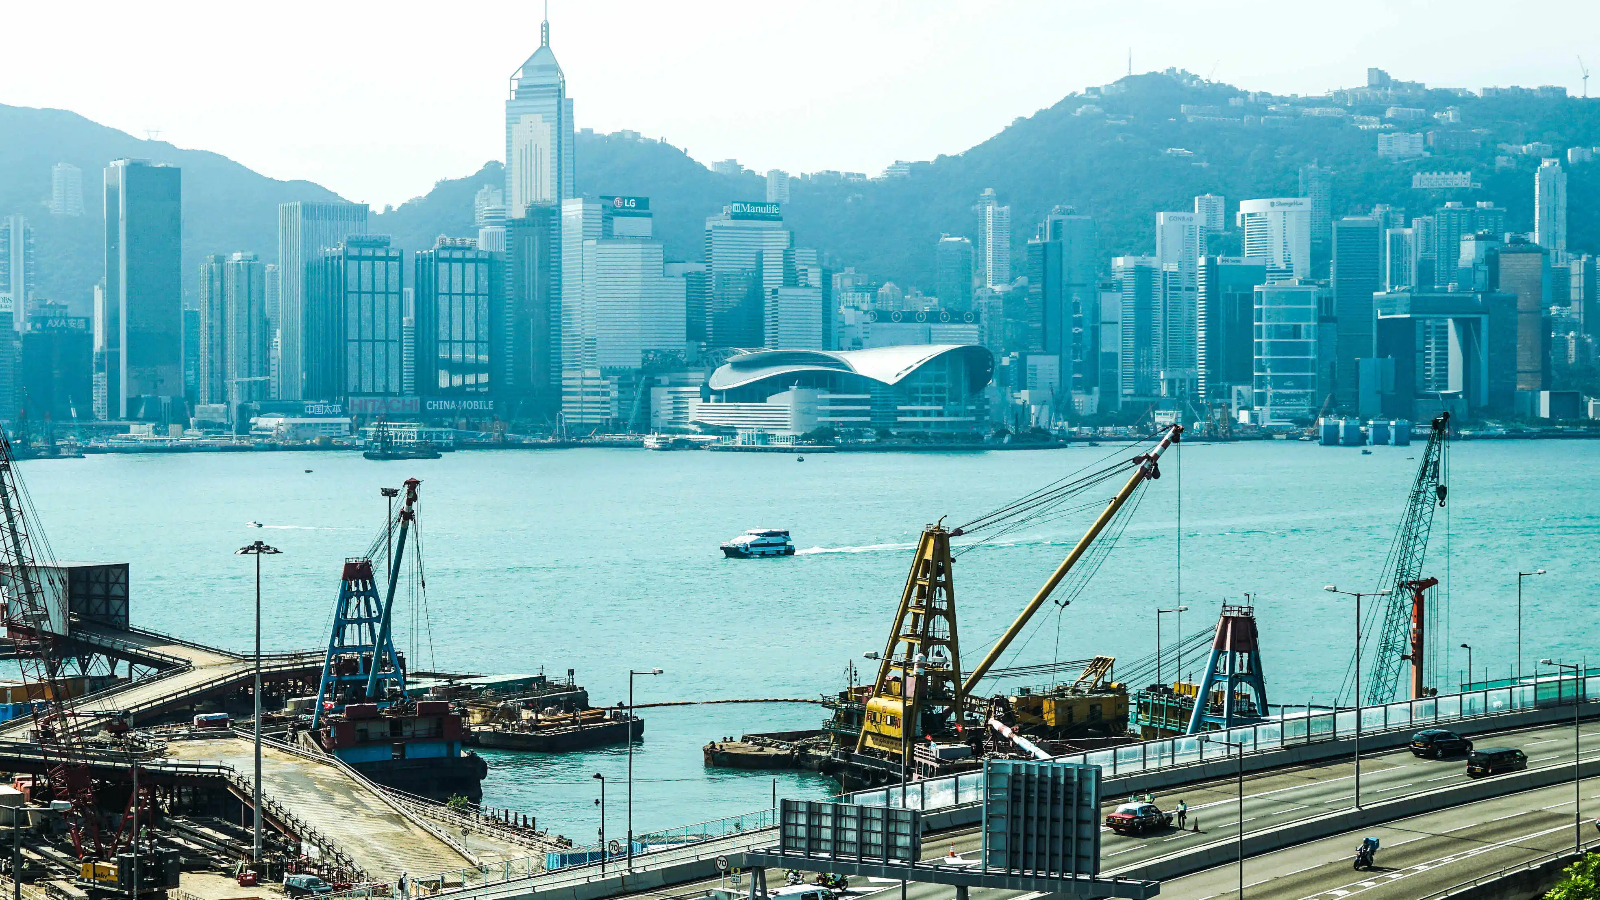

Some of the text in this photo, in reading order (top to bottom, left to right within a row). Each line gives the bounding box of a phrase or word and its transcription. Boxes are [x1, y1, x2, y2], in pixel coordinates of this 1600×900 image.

[624, 198, 636, 208] LG
[740, 203, 780, 214] Manulife
[46, 319, 66, 328] AXA
[350, 399, 419, 411] HITACHI
[426, 400, 494, 410] CHINA MOBILE
